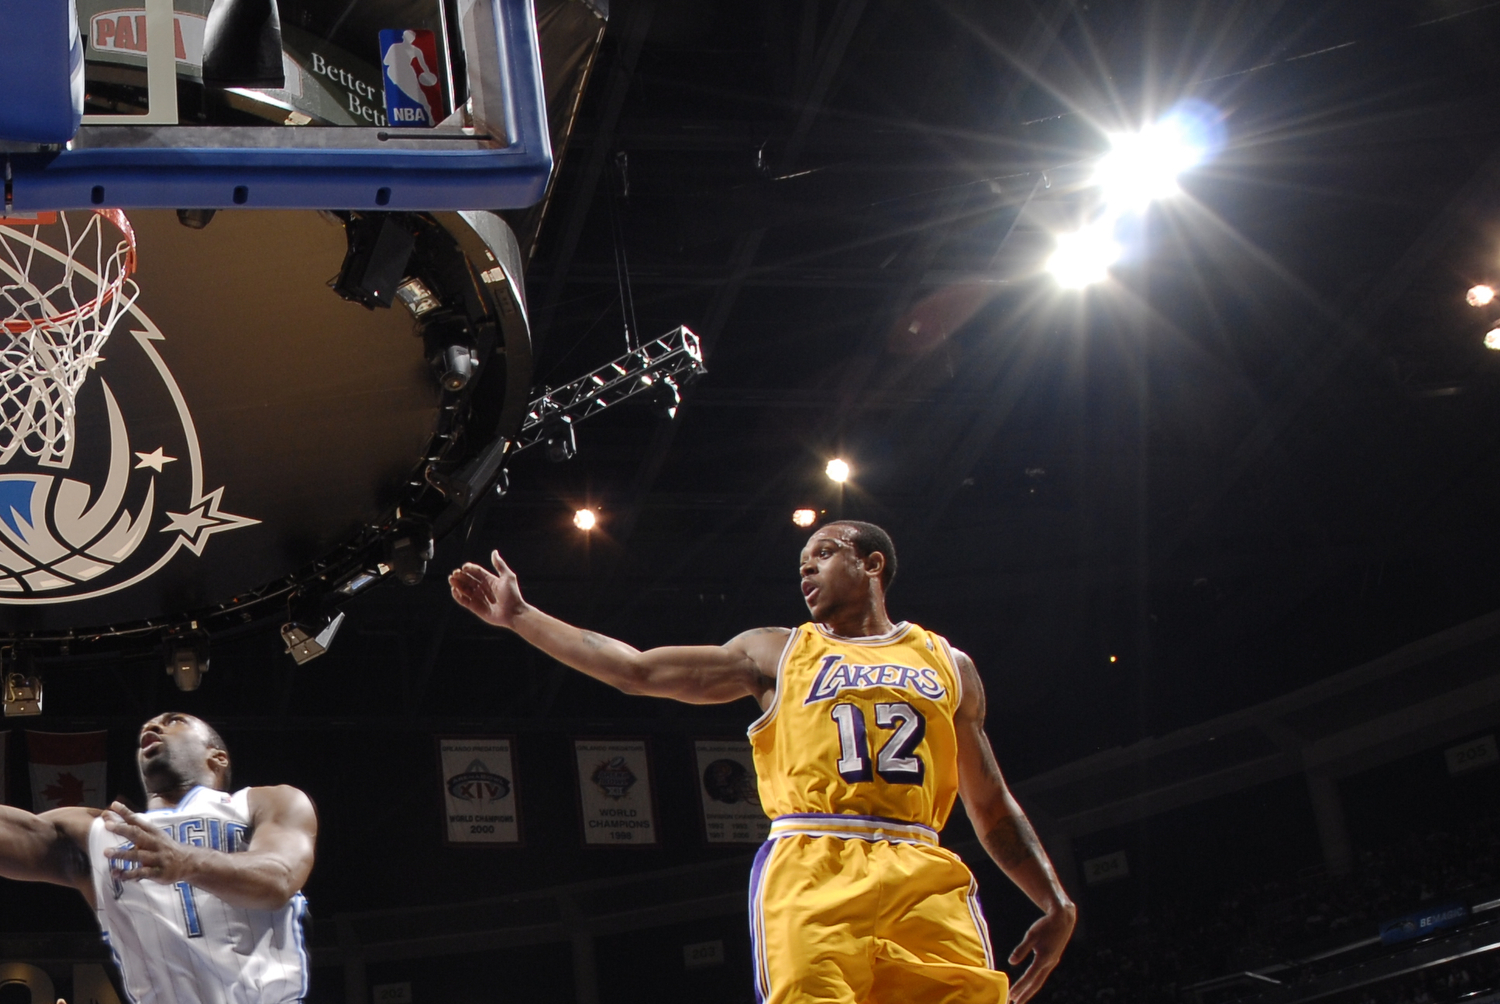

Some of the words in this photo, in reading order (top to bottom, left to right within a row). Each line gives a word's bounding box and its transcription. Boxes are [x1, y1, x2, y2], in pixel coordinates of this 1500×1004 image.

[310, 52, 376, 97] Better
[393, 107, 427, 122] NBA
[803, 654, 947, 707] LAKERS
[831, 702, 927, 786] 12
[1456, 744, 1488, 766] 205
[459, 782, 499, 799] XIV
[449, 815, 474, 823] WORLD
[474, 815, 514, 823] CHAMPIONS
[599, 808, 638, 818] WORLD
[470, 825, 495, 834] 2000
[588, 819, 651, 829] CHAMPIONS
[609, 831, 632, 841] 1998
[1092, 858, 1119, 876] 204
